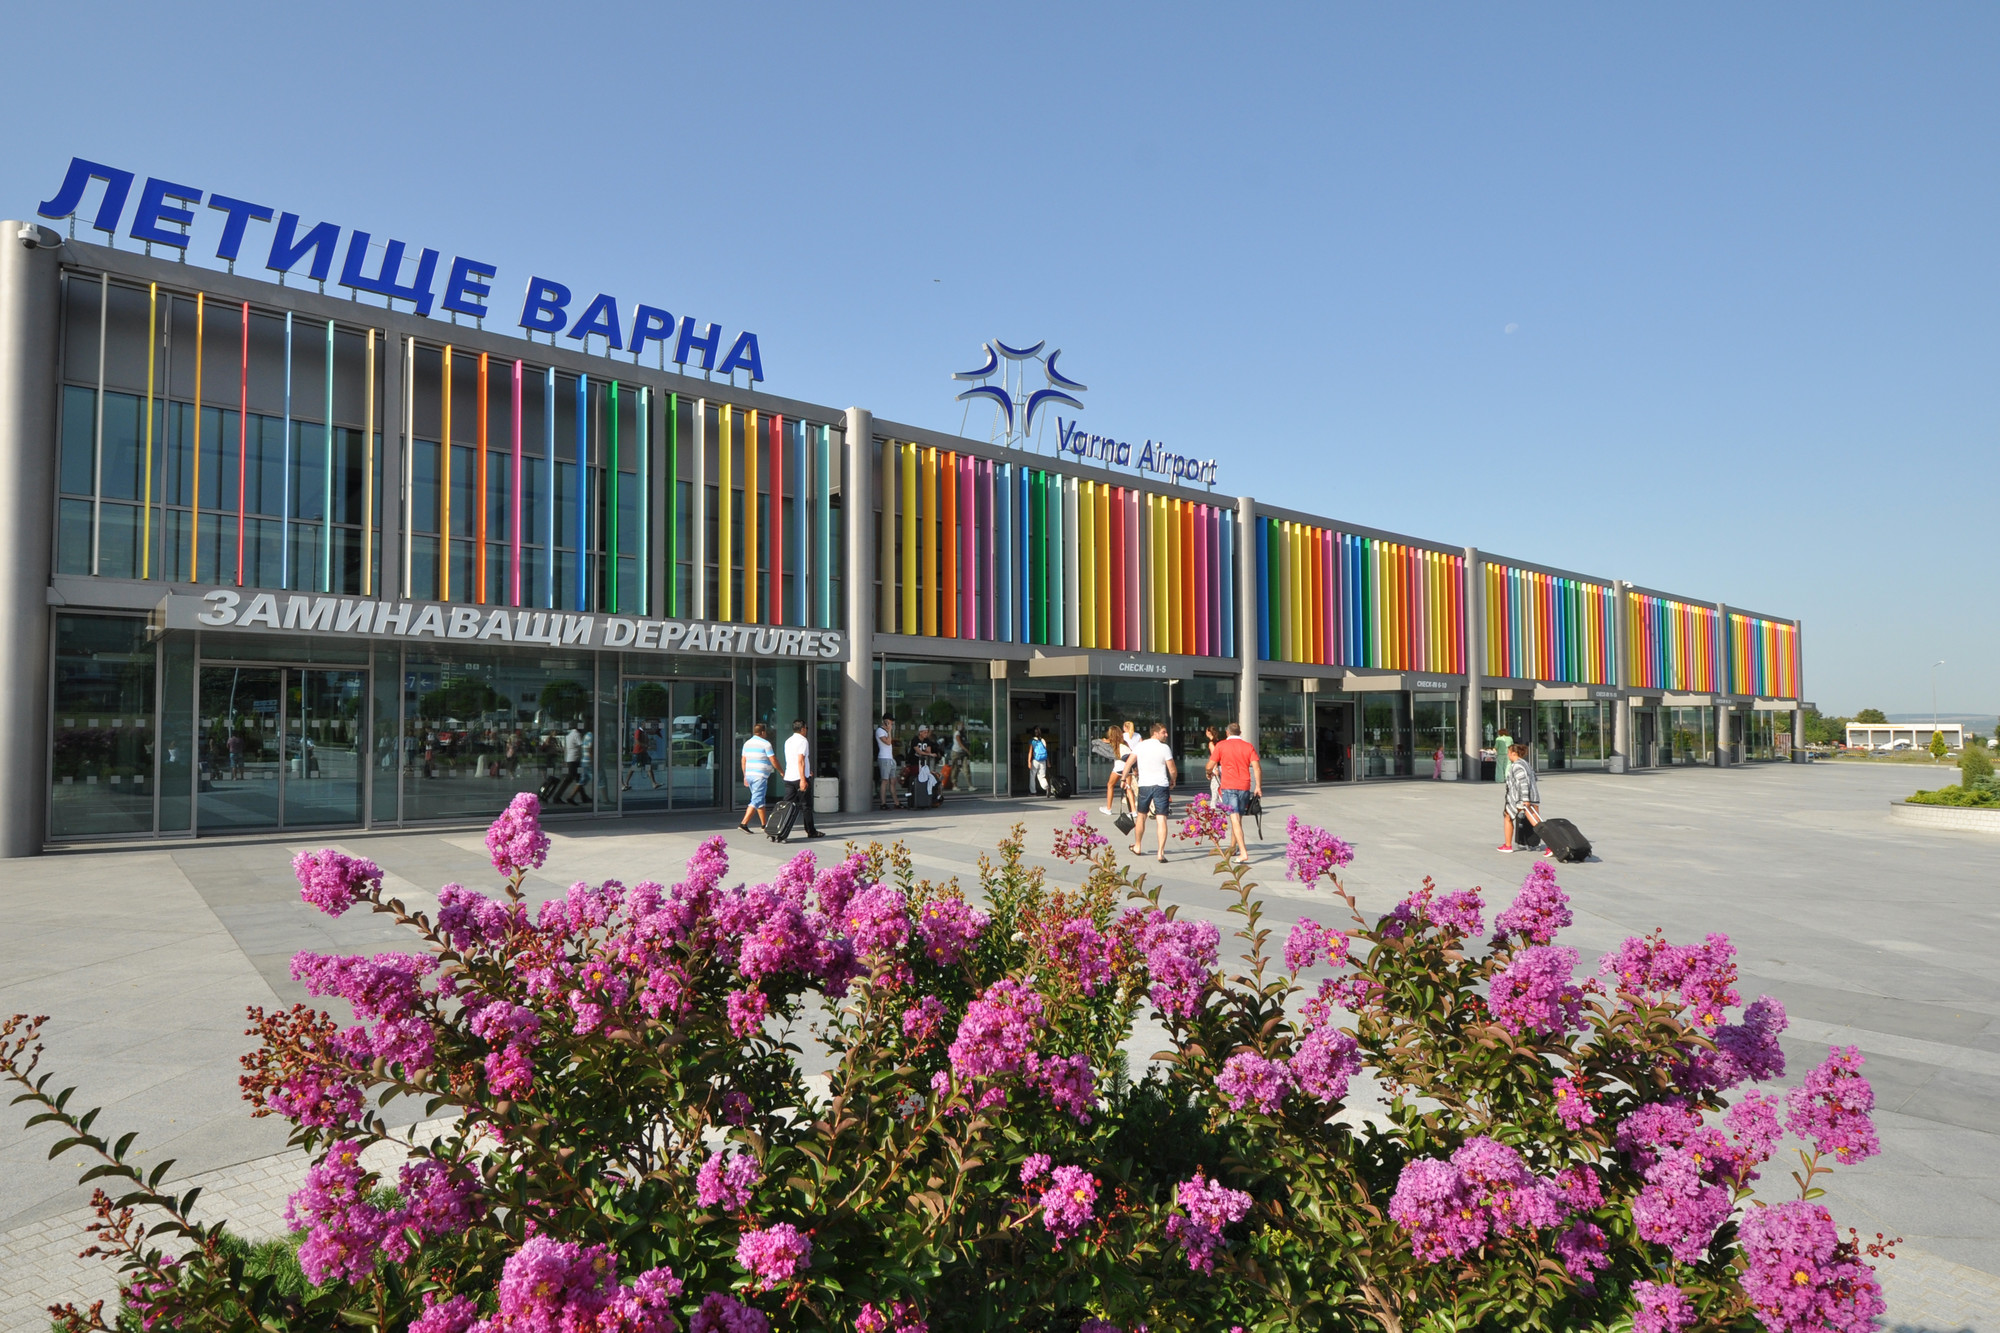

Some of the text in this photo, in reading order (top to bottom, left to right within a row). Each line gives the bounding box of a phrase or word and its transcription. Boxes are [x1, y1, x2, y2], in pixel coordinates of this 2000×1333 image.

[37, 156, 765, 382] ЛЕТИЩЕ ВАРНА
[1055, 416, 1219, 485] Varna Airport
[198, 589, 841, 658] ЗАМИНАВАЩИ DEPARTURES
[1119, 662, 1167, 673] CHECK-IN 1-5
